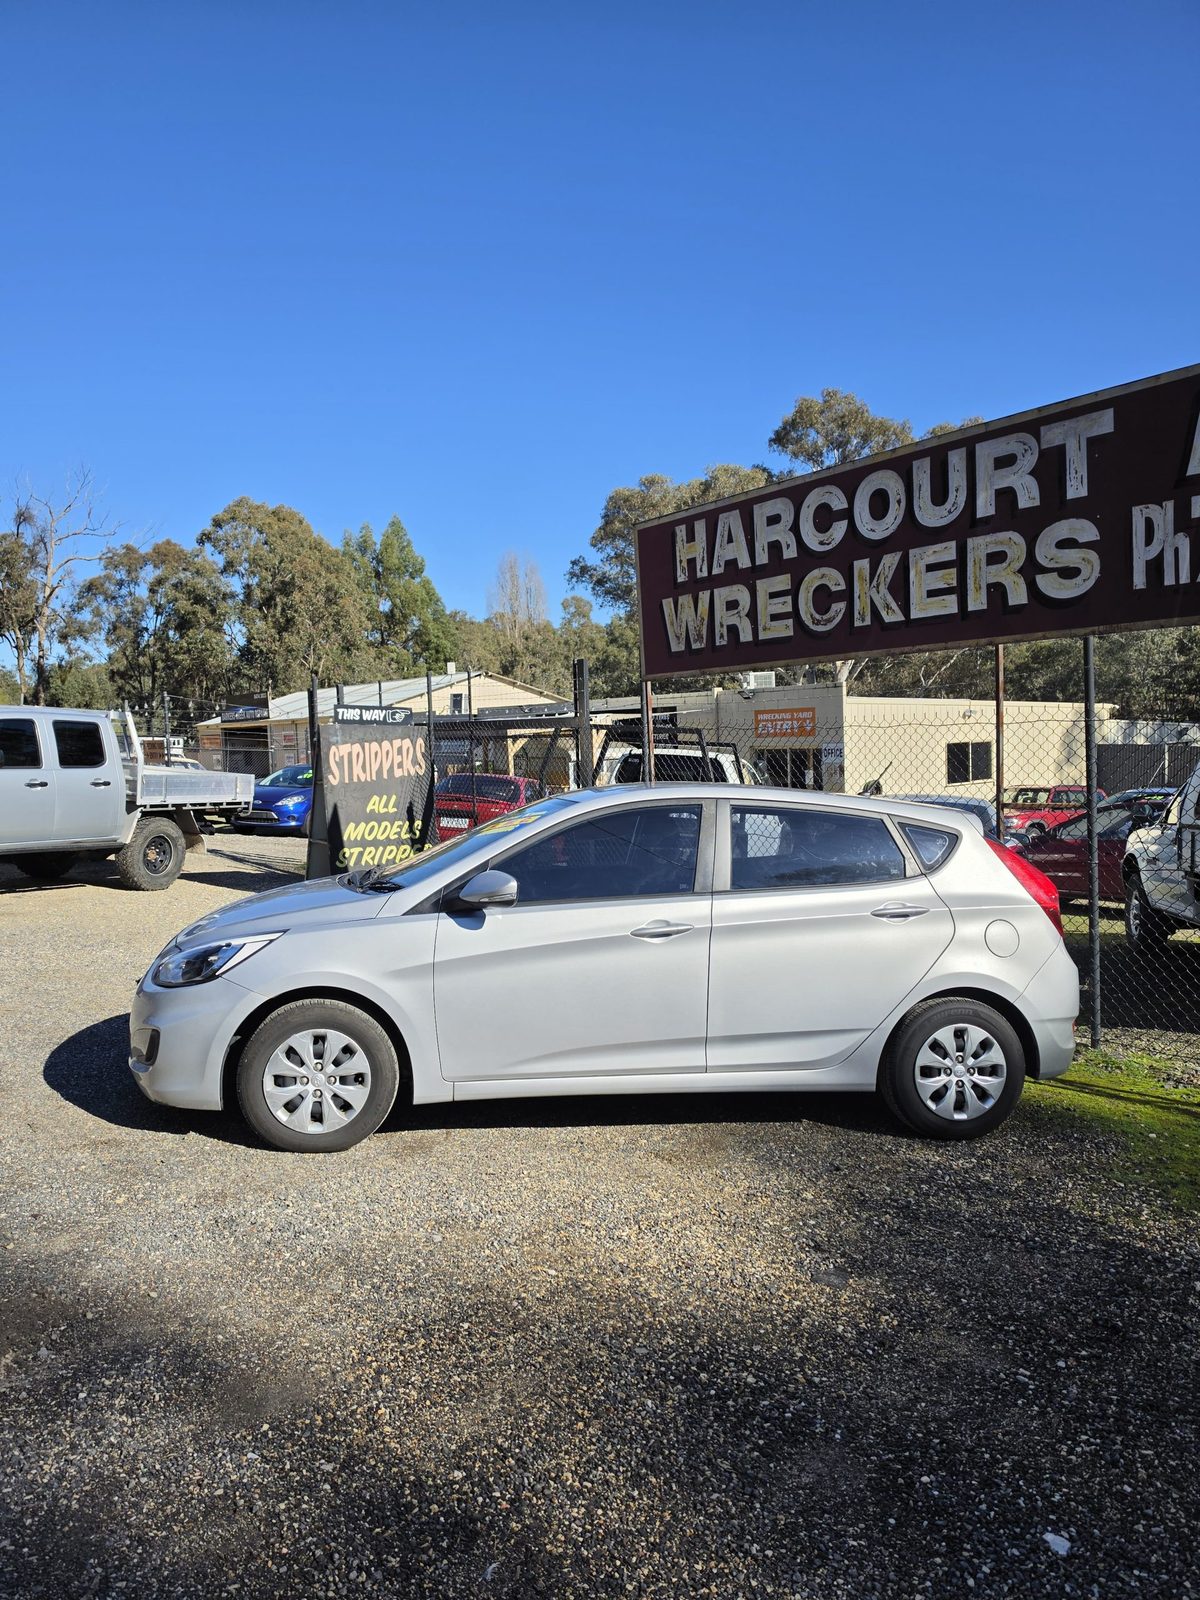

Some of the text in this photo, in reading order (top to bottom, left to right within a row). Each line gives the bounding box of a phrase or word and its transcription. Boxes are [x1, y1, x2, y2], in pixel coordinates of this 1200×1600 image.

[674, 408, 1114, 583] HARCOURT
[662, 518, 1101, 652] WRECKERS
[336, 708, 386, 721] THIS WAY
[793, 711, 813, 719] YARD
[328, 737, 426, 786] STRIPPERS
[823, 748, 843, 758] OFFICE
[366, 794, 397, 814] ALL
[343, 821, 422, 841] MODELS
